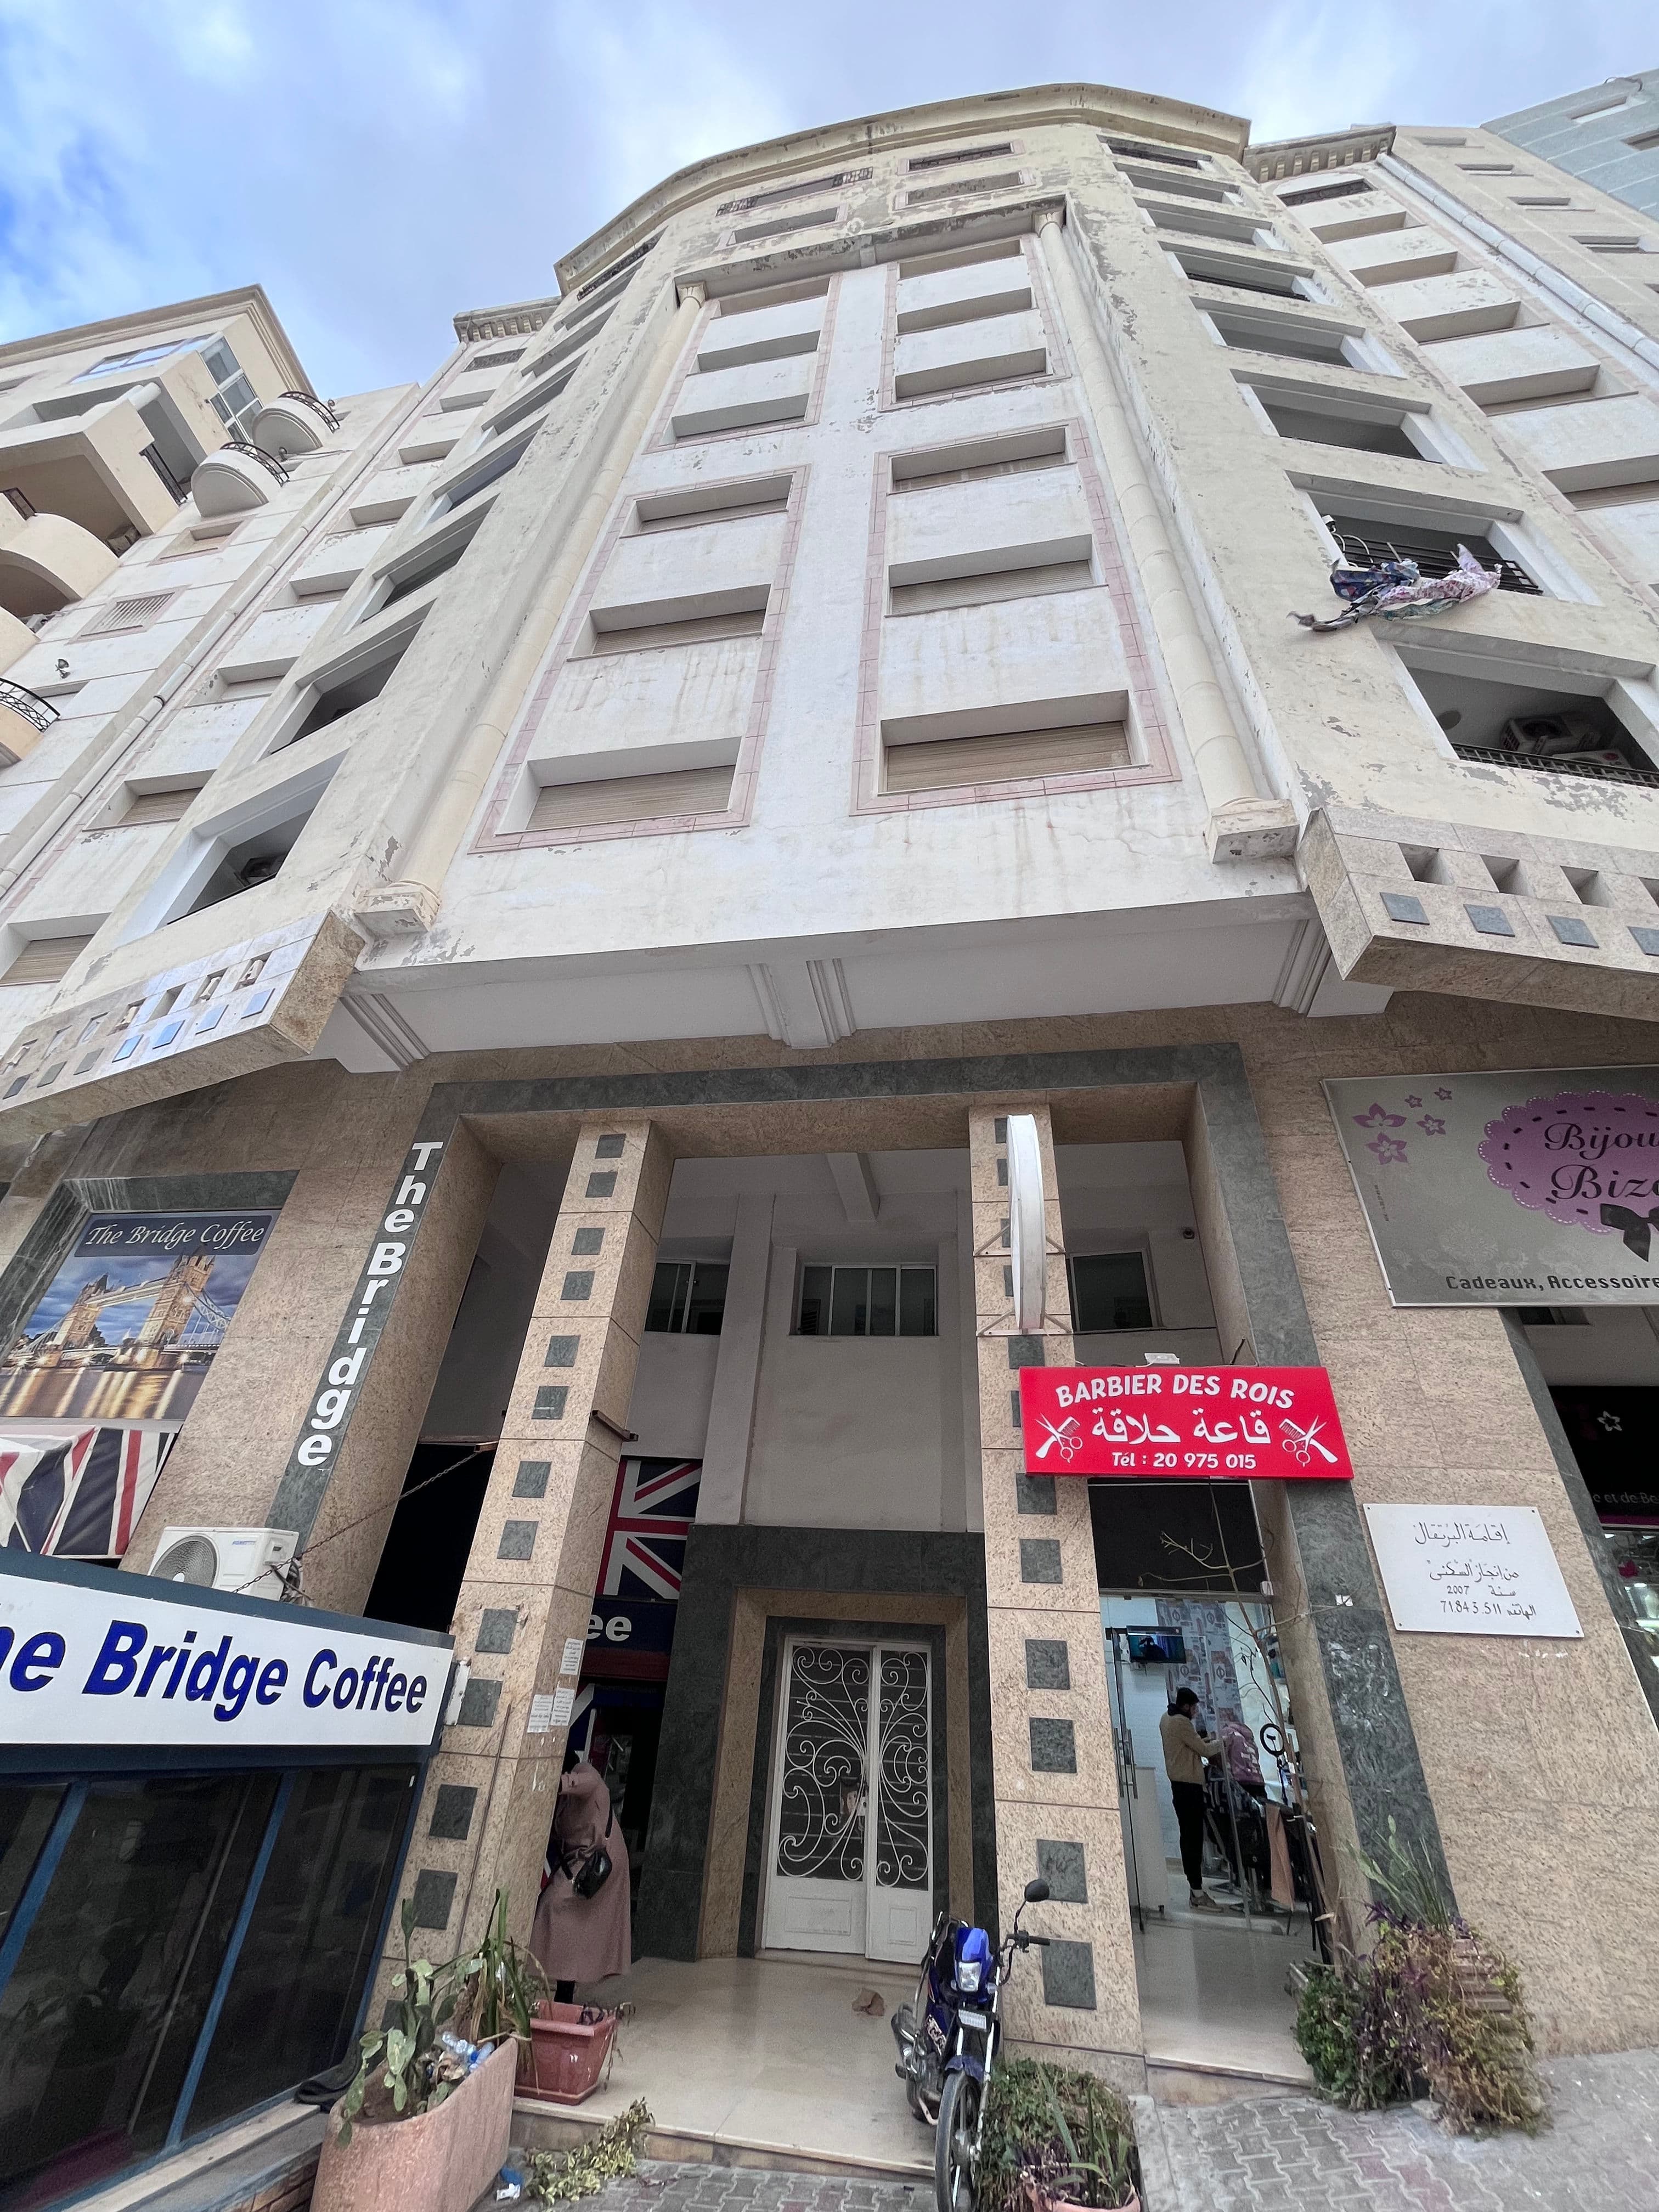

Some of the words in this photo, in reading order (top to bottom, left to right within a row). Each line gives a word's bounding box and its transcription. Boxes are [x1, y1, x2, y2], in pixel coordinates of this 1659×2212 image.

[383, 1141, 444, 1233] The
[85, 1223, 123, 1245] The
[125, 1222, 196, 1250] Bridge
[200, 1221, 264, 1250] Coffee
[1445, 1276, 1544, 1291] Cadeaux,
[297, 1242, 407, 1466] Bridge
[1055, 1373, 1162, 1408] BARBIER
[1172, 1374, 1221, 1396] DES
[1230, 1378, 1295, 1409] ROIS
[1092, 1407, 1181, 1444] حلاقة
[1192, 1407, 1271, 1444] قاعة
[1112, 1452, 1136, 1466] Tél
[1153, 1452, 1177, 1468] 20
[1184, 1452, 1219, 1469] 975
[1226, 1453, 1257, 1469] 015
[1447, 1585, 1469, 1595] 2007
[1487, 1585, 1516, 1596] سنة
[1503, 1568, 1519, 1581] من
[0, 1626, 66, 1692] e
[81, 1620, 289, 1722] Bridge
[302, 1648, 428, 1713] Coffee
